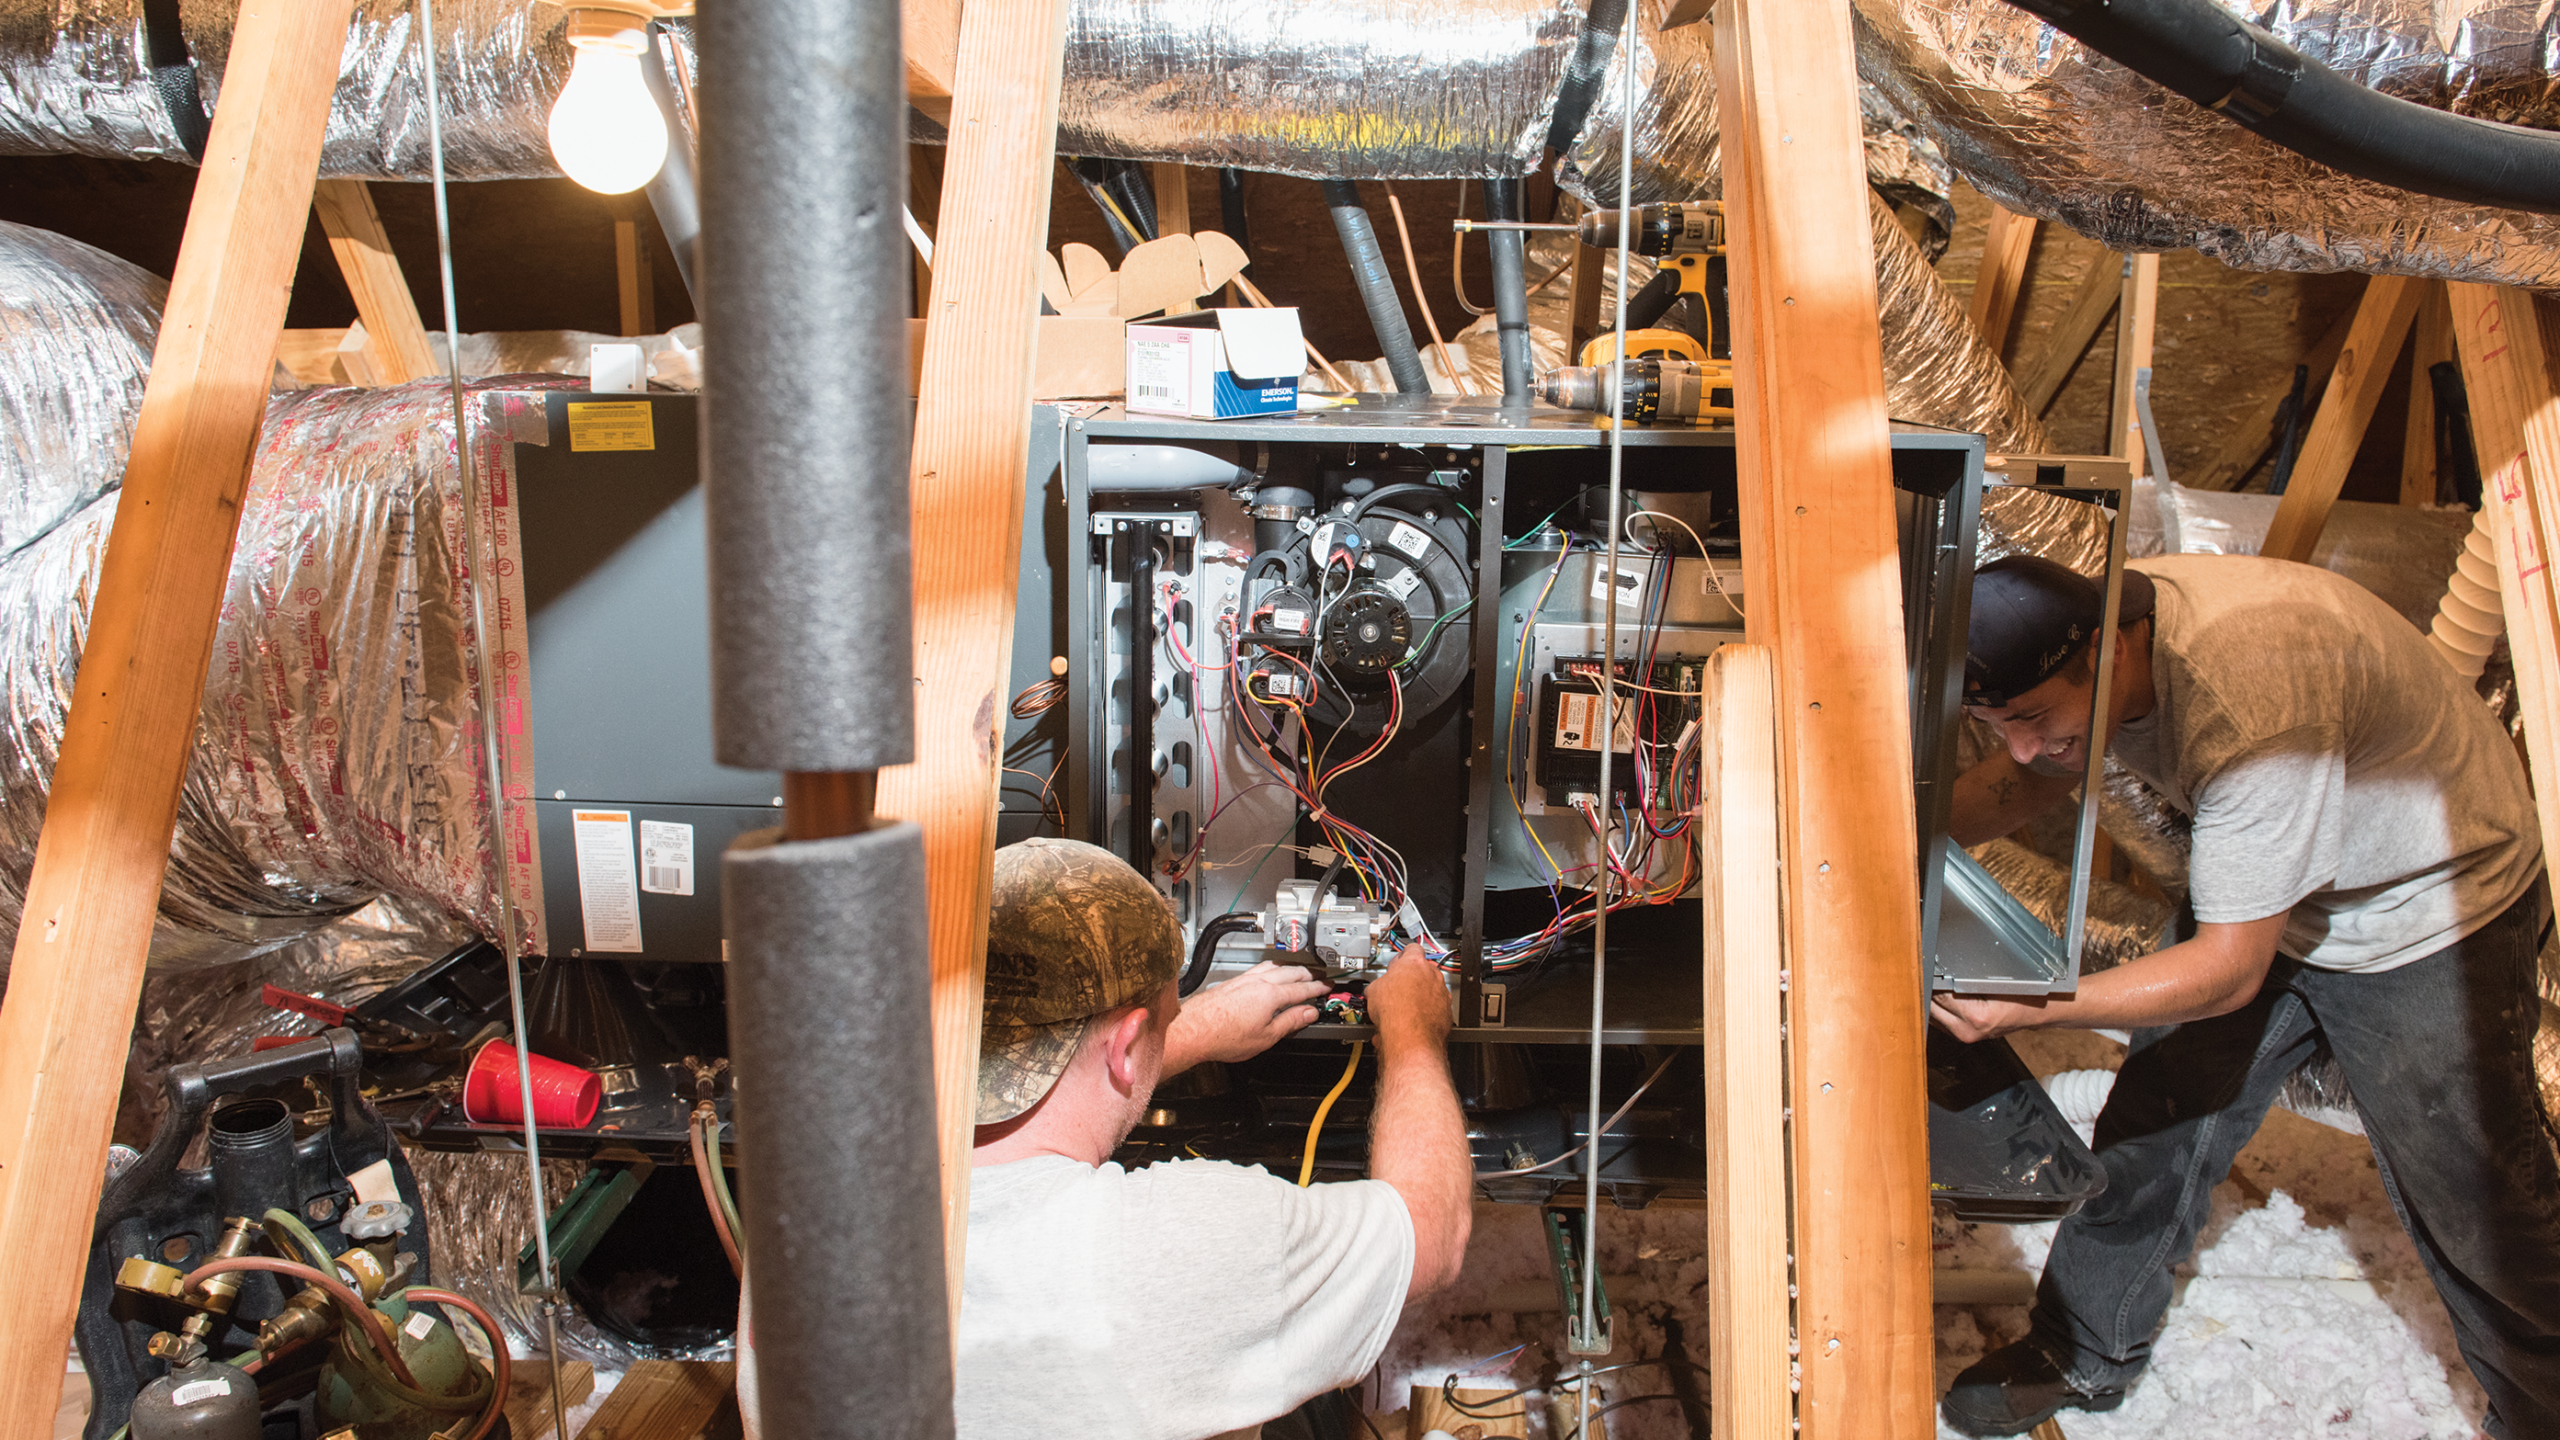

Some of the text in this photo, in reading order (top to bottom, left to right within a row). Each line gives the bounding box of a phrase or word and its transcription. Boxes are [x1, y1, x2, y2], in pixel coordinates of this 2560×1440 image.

[495, 510, 506, 525] AF
[497, 529, 508, 546] 100
[498, 597, 512, 630] 07/15
[309, 610, 328, 663] Shurtape
[319, 690, 331, 707] 100
[510, 737, 521, 751] AF
[519, 866, 530, 880] AF
[520, 883, 532, 900] 100
